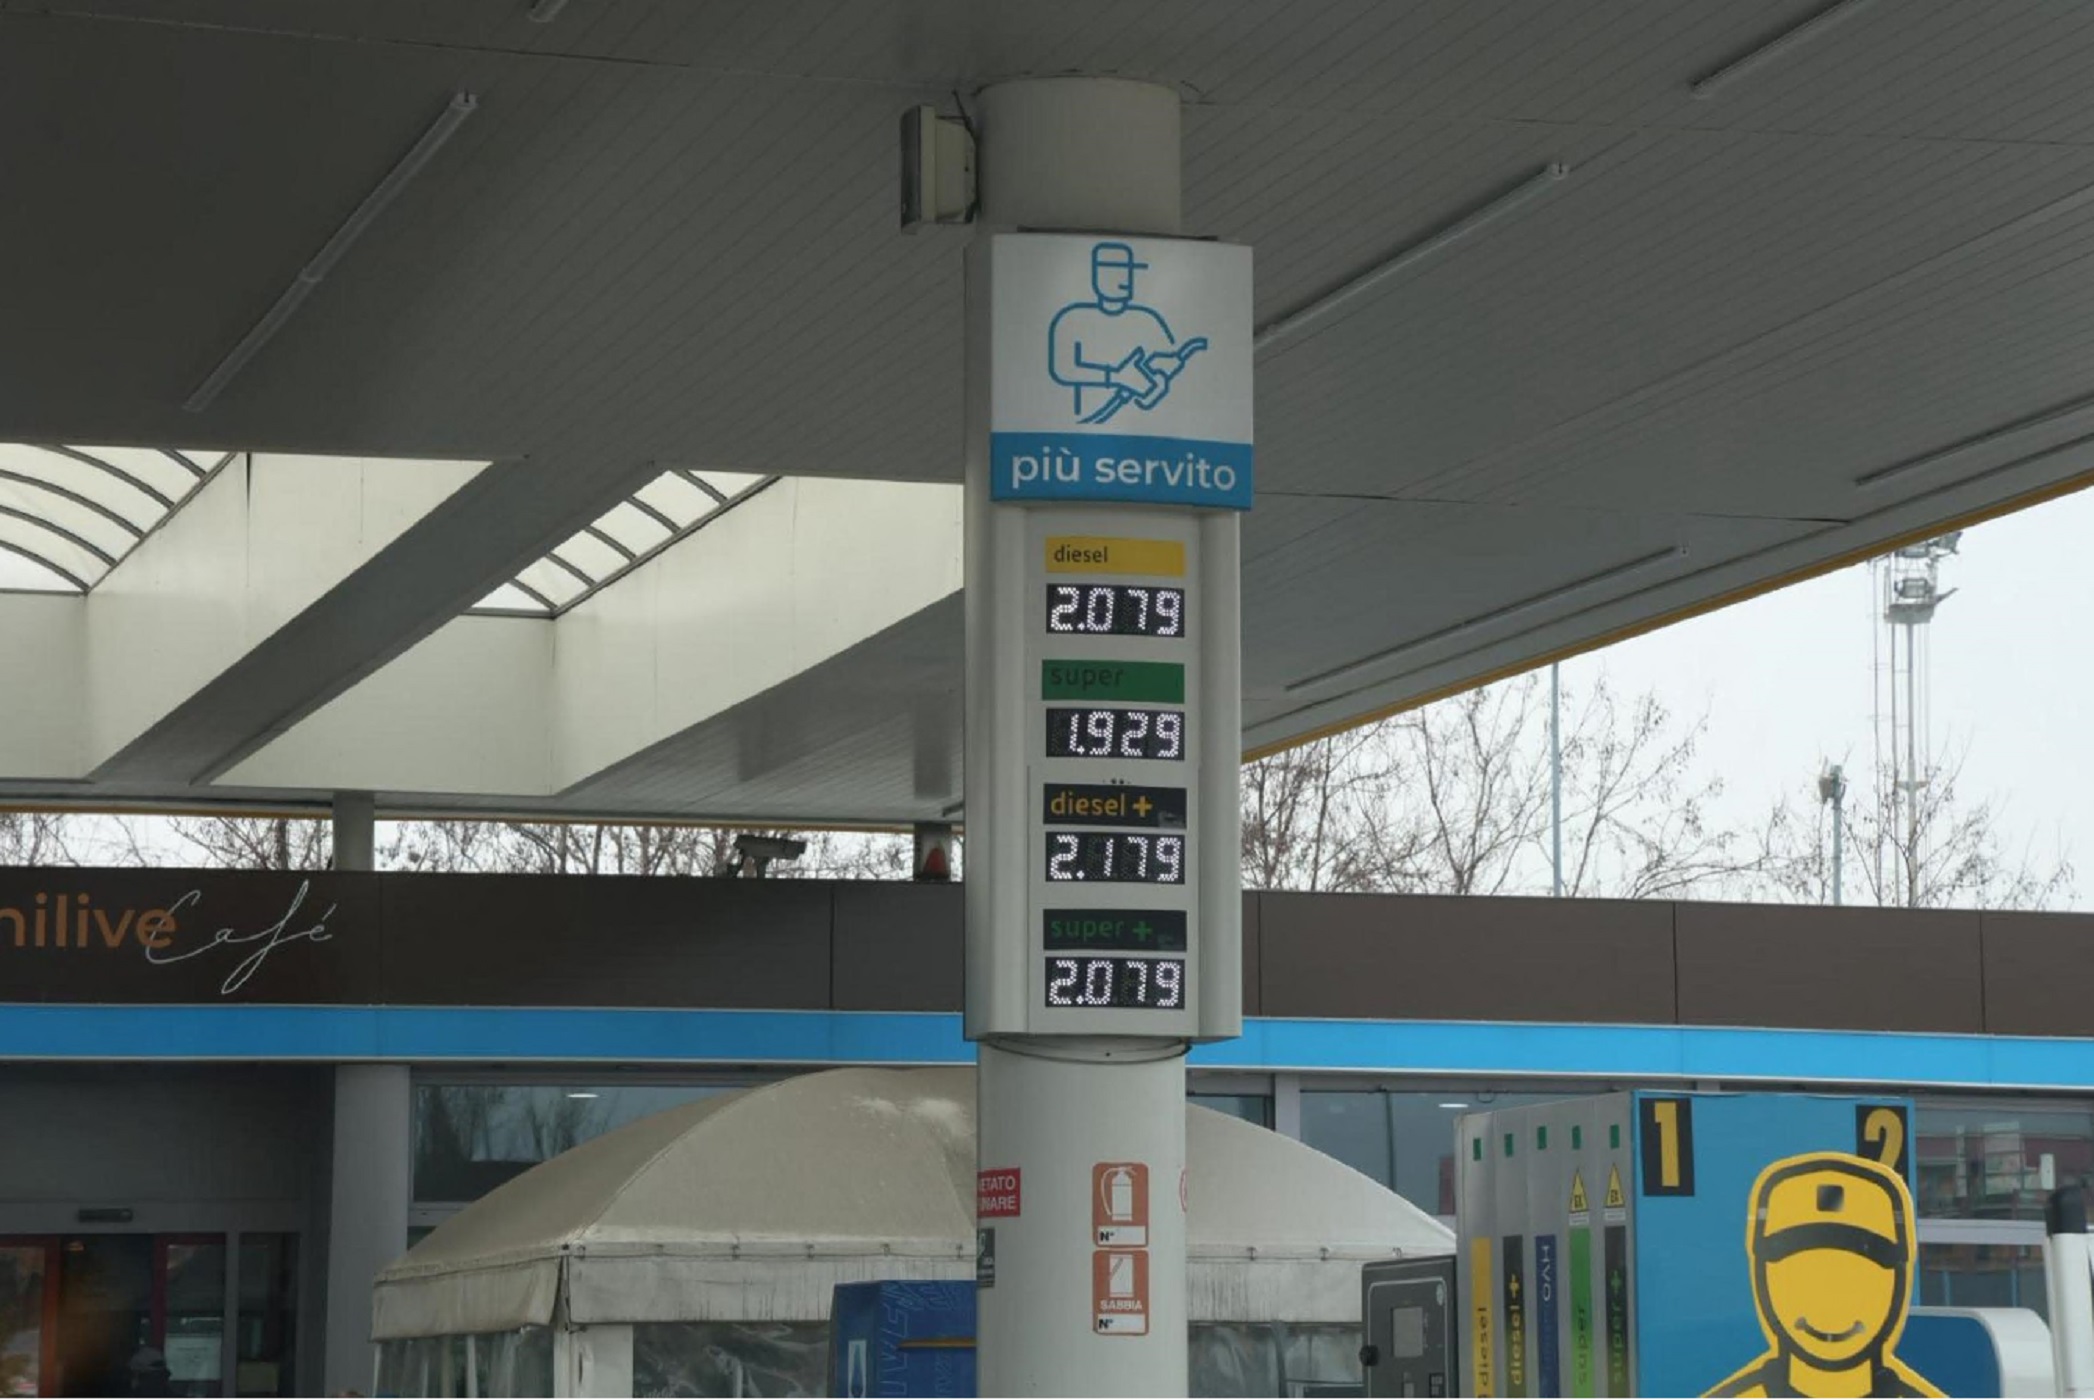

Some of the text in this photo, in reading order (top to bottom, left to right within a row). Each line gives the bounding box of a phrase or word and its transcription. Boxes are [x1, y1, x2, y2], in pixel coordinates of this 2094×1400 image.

[1011, 446, 1236, 491] più servito
[1053, 544, 1109, 564] diesel
[1050, 586, 1181, 636] 2.079
[1050, 667, 1125, 690] super
[1068, 711, 1181, 758] 1.929
[1050, 791, 1126, 817] diesel
[1050, 834, 1181, 882] 2.179
[1050, 919, 1125, 940] super
[1049, 959, 1181, 1007] 2.079
[1654, 1100, 1681, 1188] 1
[1864, 1108, 1904, 1169] 2
[1100, 1300, 1142, 1311] SABBIA
[1477, 1306, 1490, 1386] diesel
[1509, 1304, 1522, 1386] diesel
[1576, 1304, 1588, 1386] super
[1610, 1302, 1625, 1384] super
